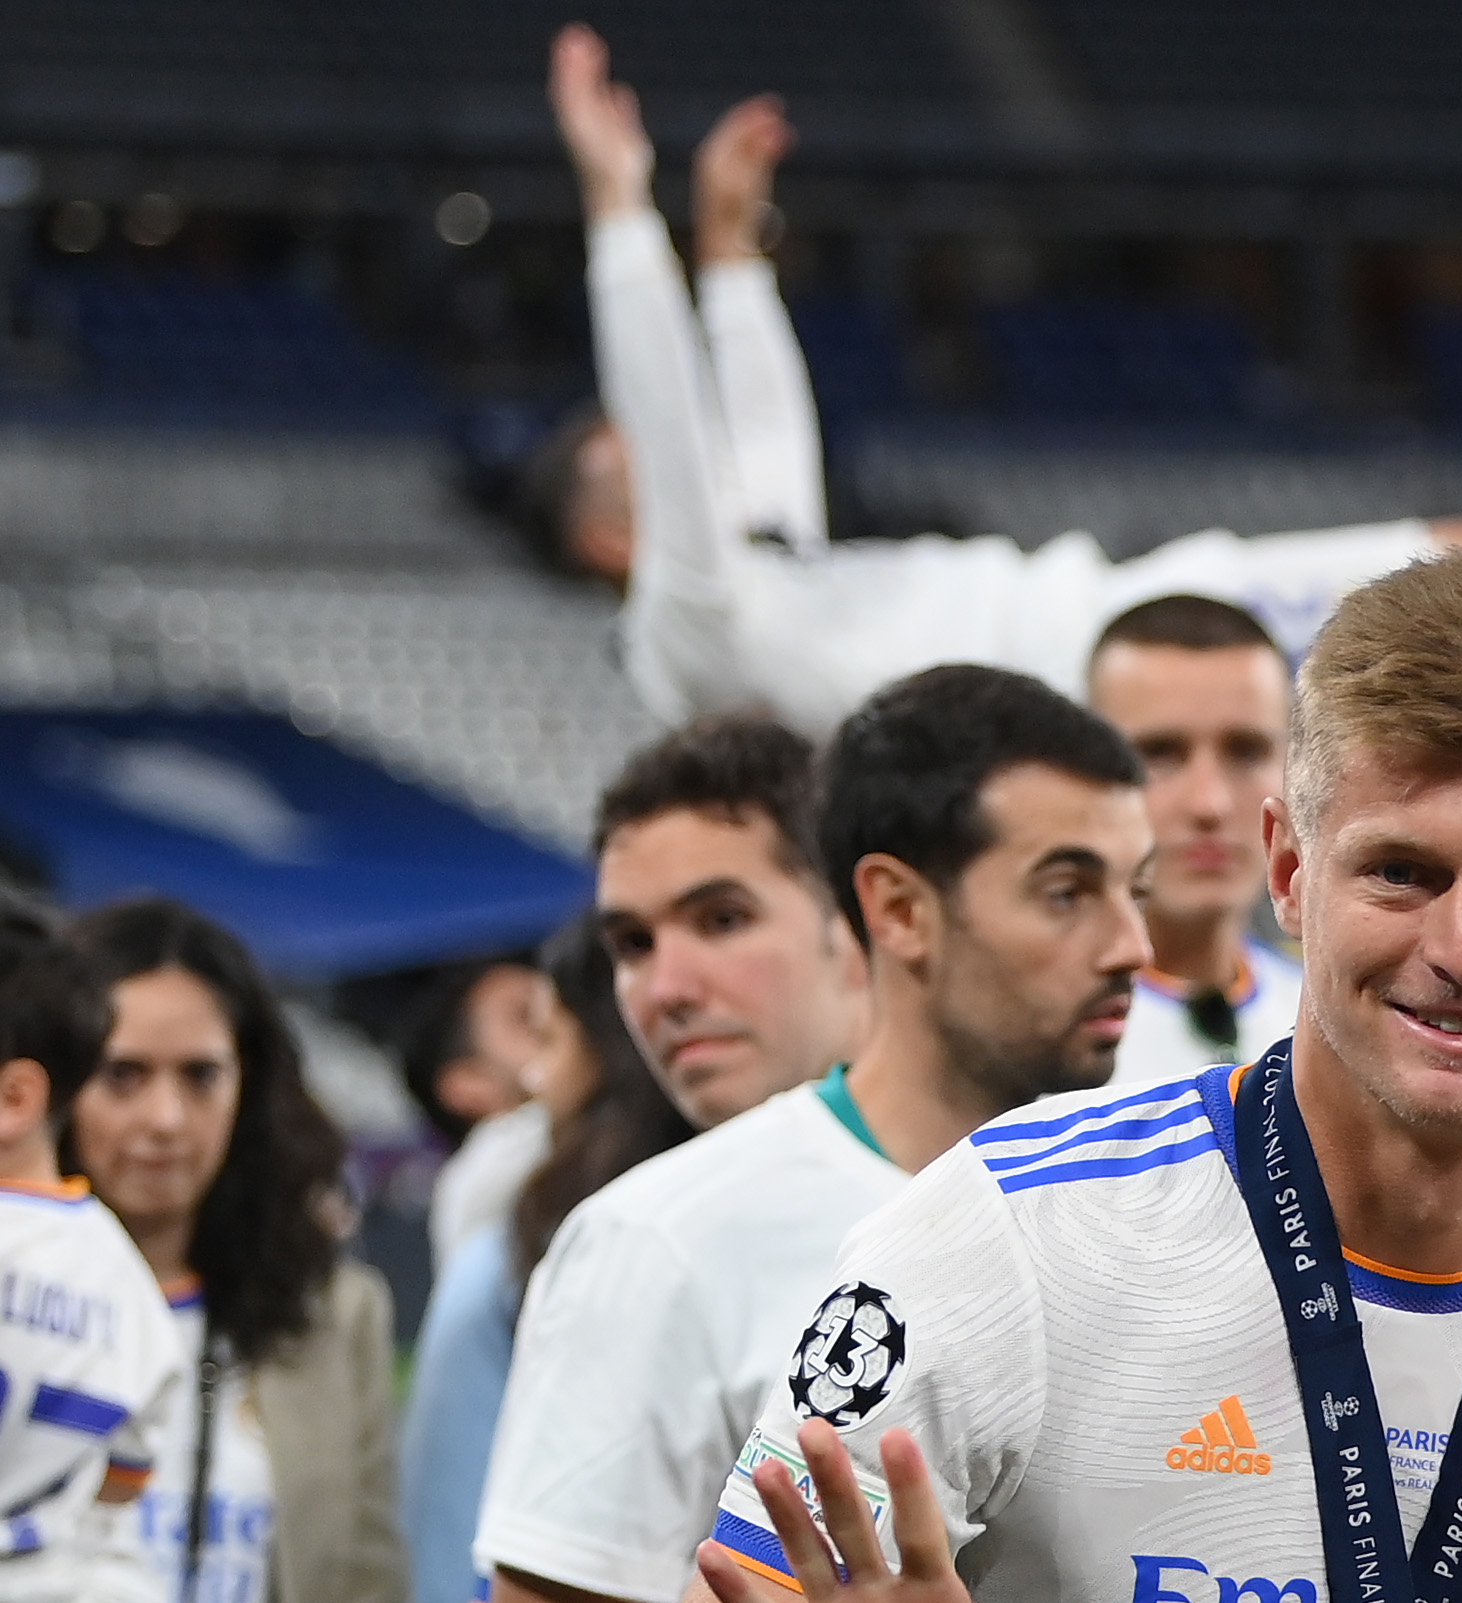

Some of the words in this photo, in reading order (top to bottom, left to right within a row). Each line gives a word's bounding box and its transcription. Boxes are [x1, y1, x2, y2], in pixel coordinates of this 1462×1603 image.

[1275, 1187, 1317, 1272] PARIS
[807, 1315, 880, 1388] 13
[1165, 1443, 1271, 1476] adidas
[1386, 1427, 1450, 1454] PARIS
[1339, 1446, 1371, 1527] PARIS
